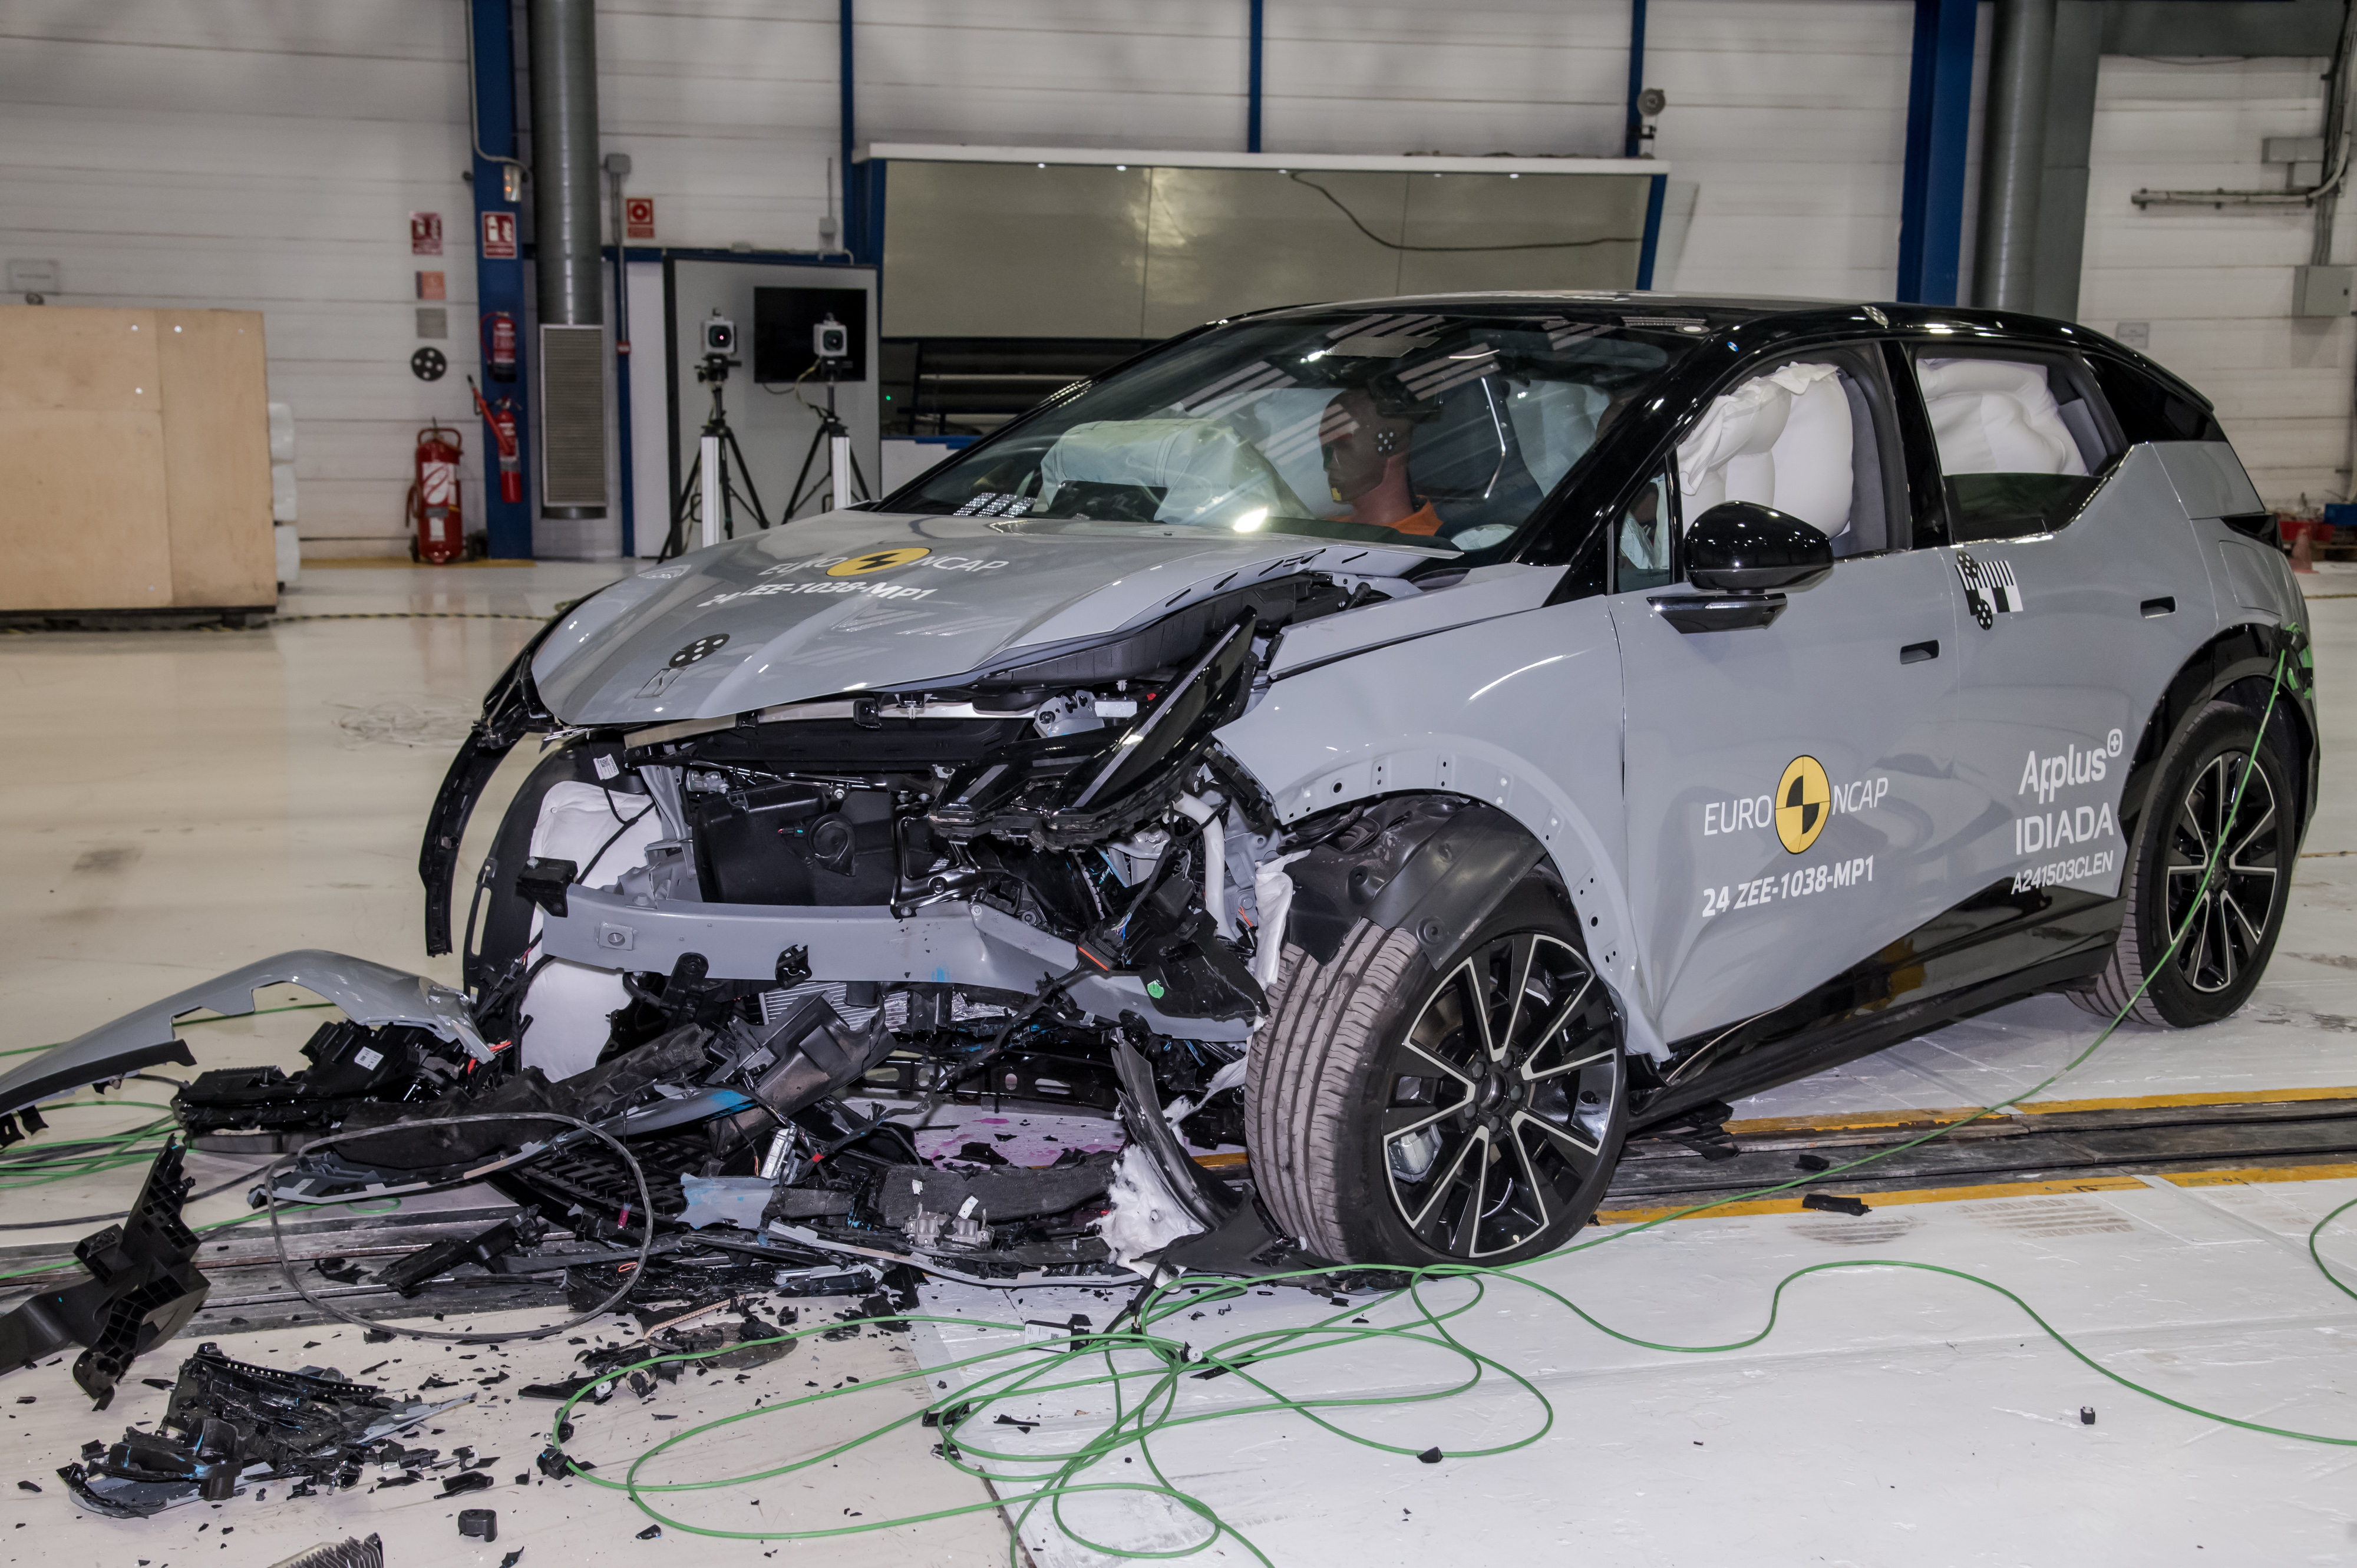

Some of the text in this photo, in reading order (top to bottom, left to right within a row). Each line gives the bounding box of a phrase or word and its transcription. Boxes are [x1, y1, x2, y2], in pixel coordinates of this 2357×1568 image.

[757, 556, 1010, 576] EURO NCAP
[1704, 777, 1889, 836] EURO NCAP
[2016, 802, 2114, 855] IDIADA
[1702, 854, 1874, 917] 24 ZEE-1038-MP1
[2011, 850, 2114, 895] A241503CLEN
